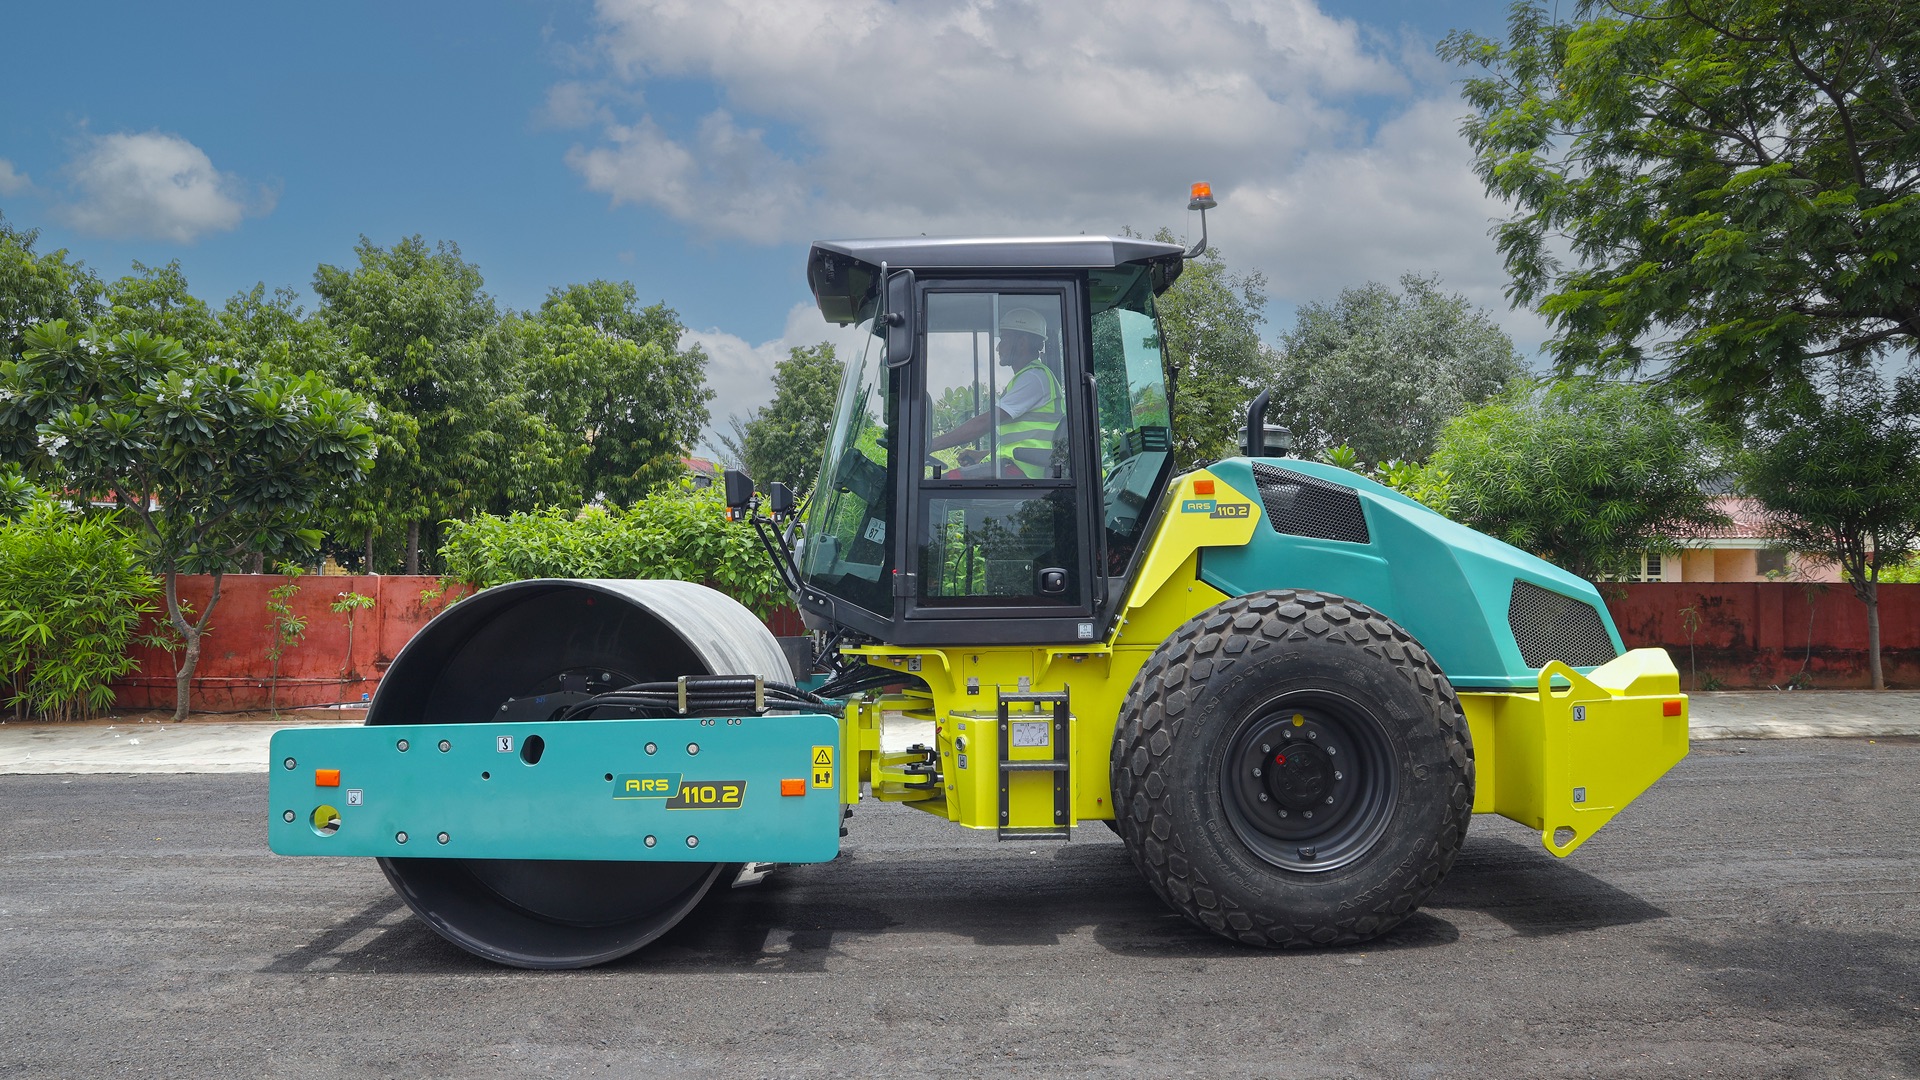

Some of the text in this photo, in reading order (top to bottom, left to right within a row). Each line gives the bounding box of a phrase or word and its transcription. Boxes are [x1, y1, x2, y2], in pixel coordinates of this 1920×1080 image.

[1187, 502, 1248, 516] ARS 110.2
[868, 527, 879, 539] 87
[1191, 651, 1302, 738] COMPACTOR
[625, 779, 739, 804] ARS 110.2
[1336, 837, 1426, 912] GALAXY
